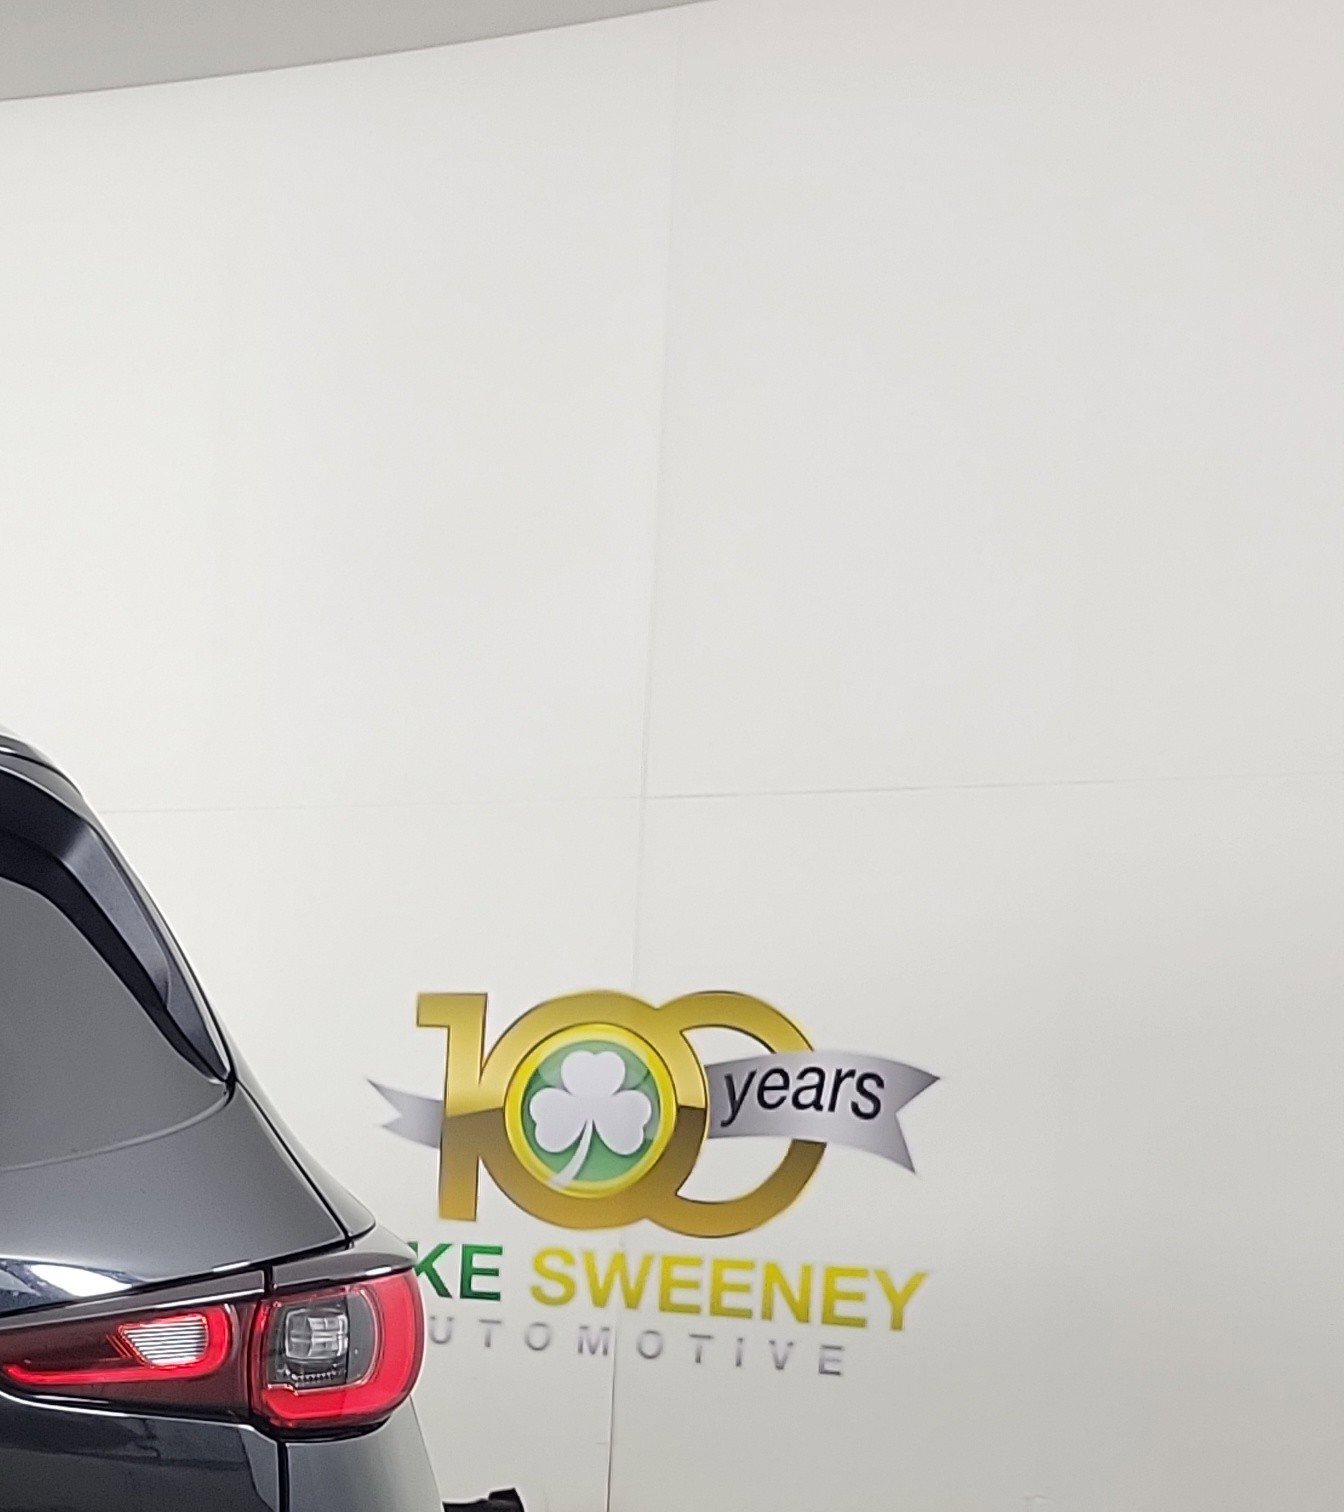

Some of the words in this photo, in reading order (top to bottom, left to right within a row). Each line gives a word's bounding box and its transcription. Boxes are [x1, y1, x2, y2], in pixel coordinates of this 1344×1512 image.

[719, 1065, 886, 1128] years
[407, 1241, 504, 1301] KE
[529, 1246, 929, 1332] SWEENEY
[428, 1314, 846, 1377] UTOMOTIVE
